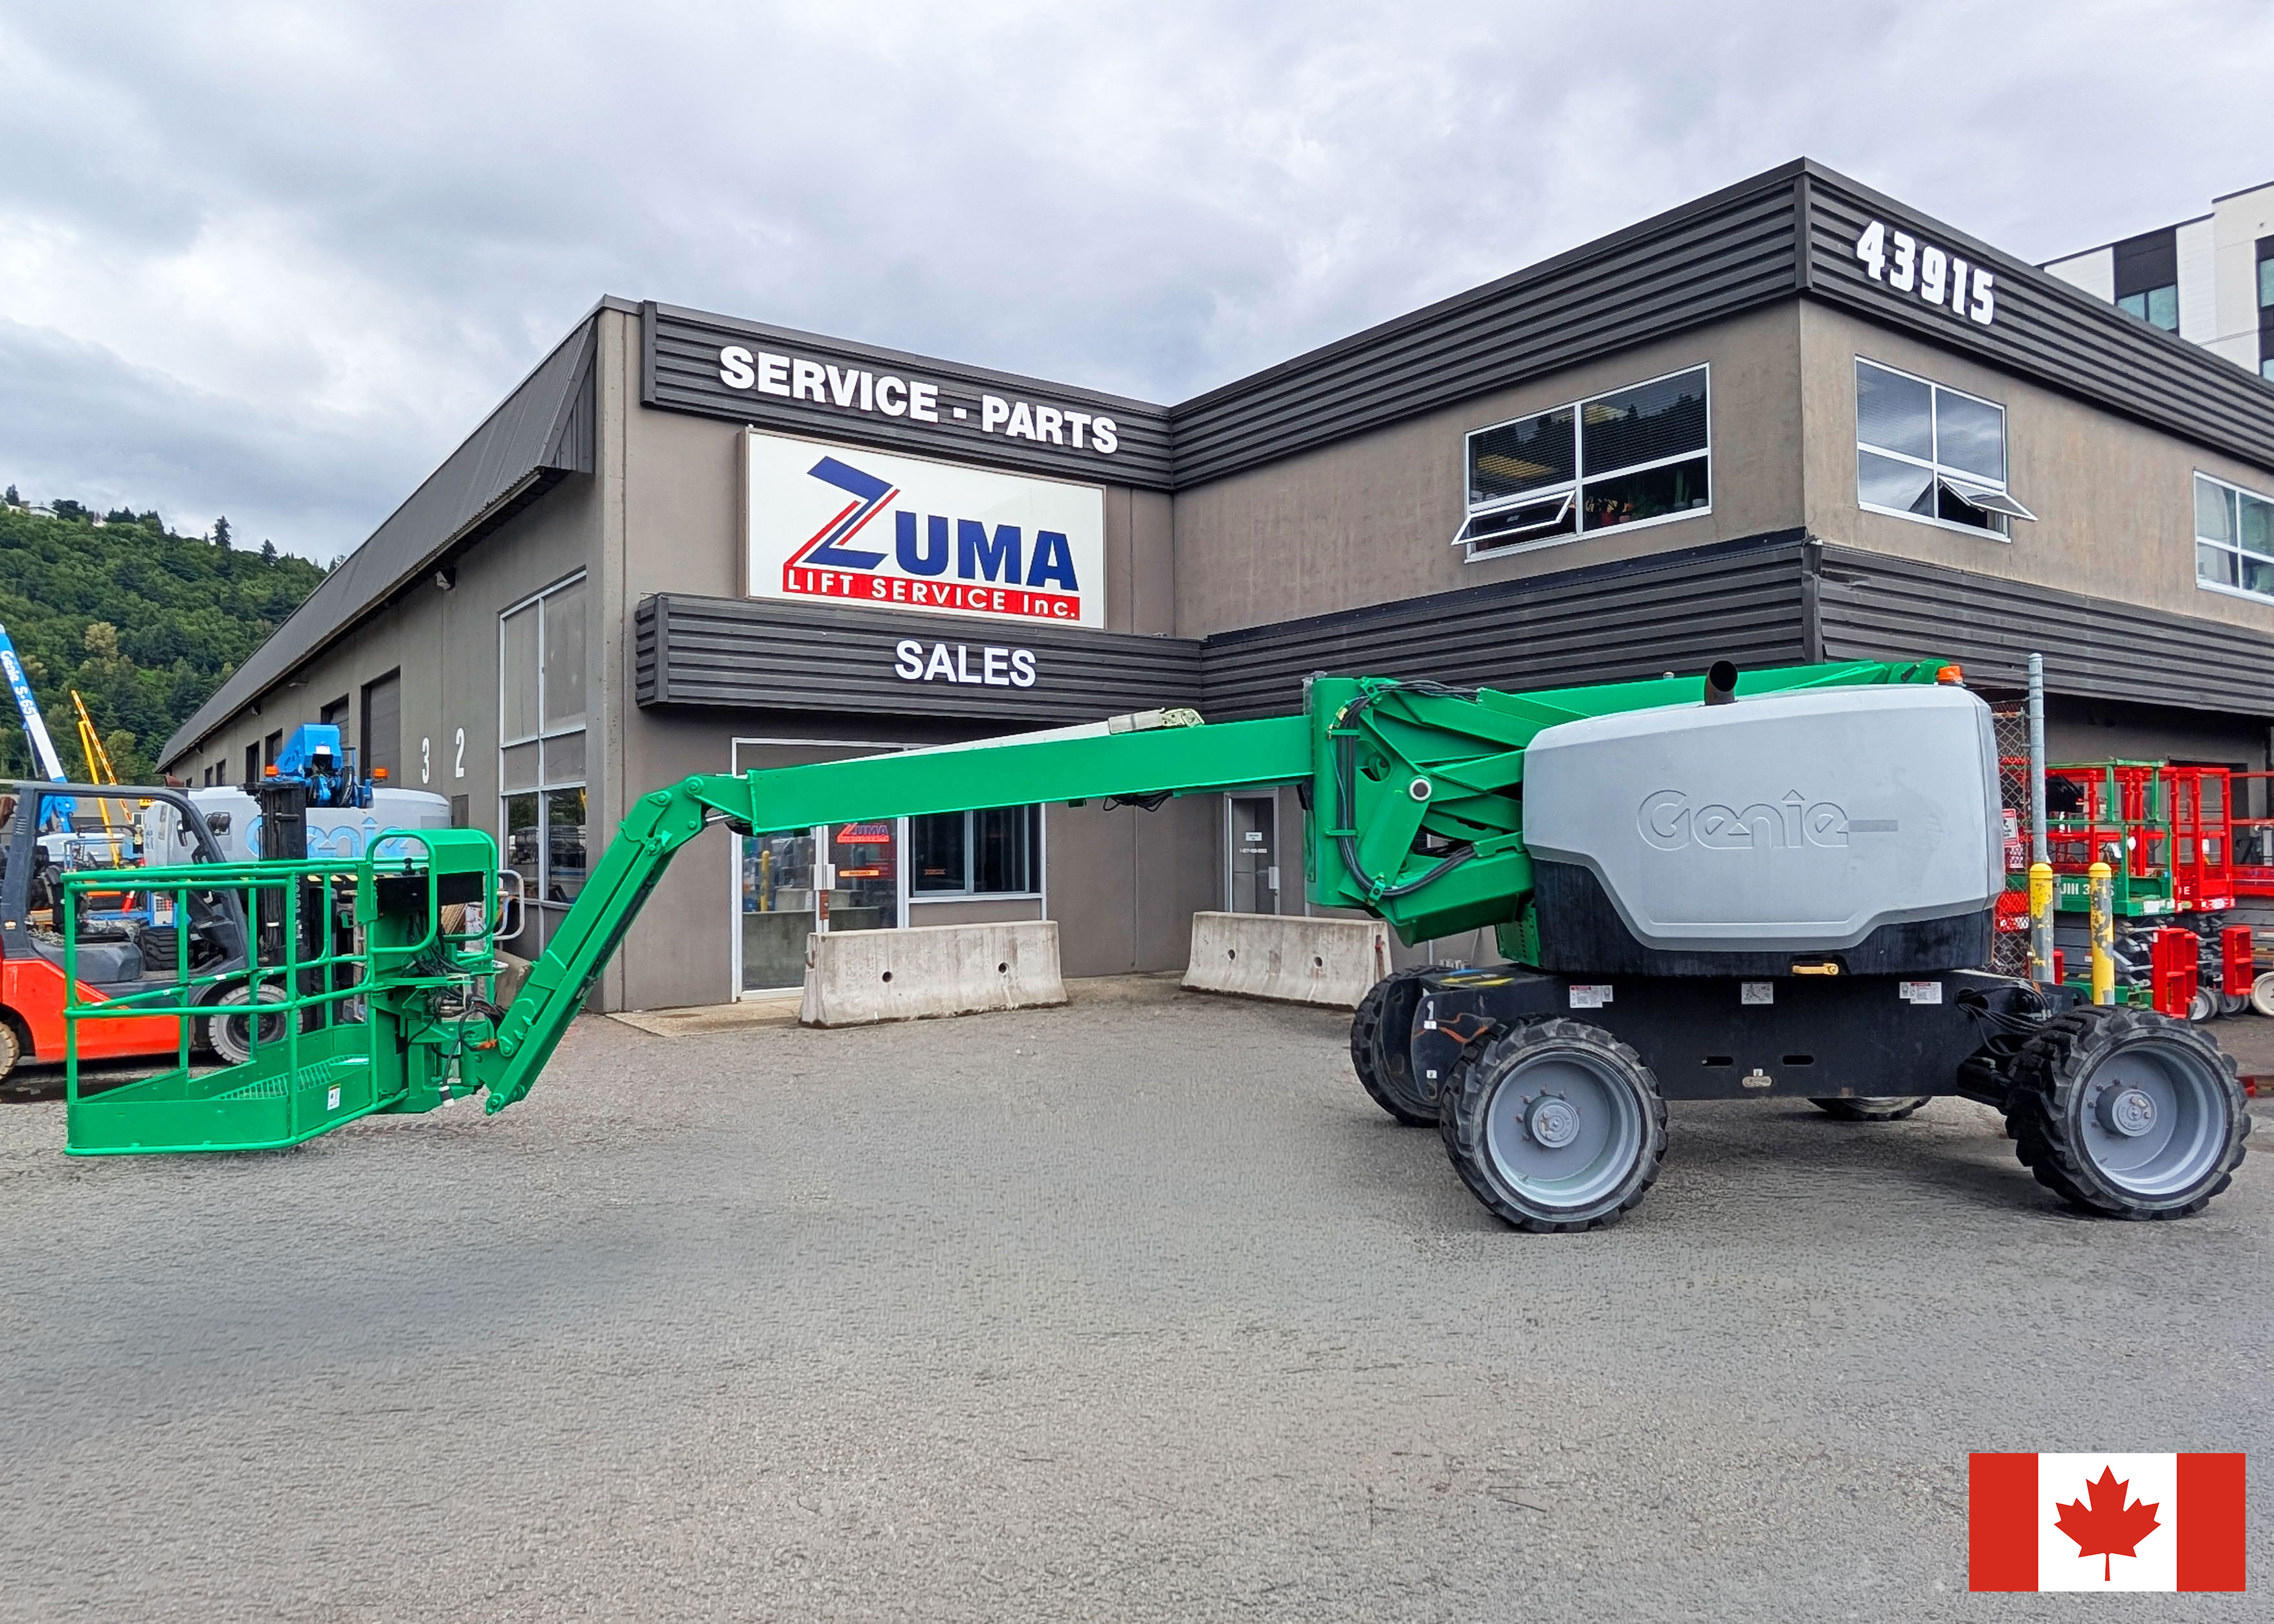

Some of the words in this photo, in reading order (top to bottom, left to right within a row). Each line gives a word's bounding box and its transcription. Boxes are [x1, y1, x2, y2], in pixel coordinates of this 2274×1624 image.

[1856, 220, 1994, 325] 43915
[720, 346, 938, 423] SERVICE
[982, 395, 1118, 454] PARTS
[788, 456, 1079, 592] ZUMA
[788, 570, 854, 595] LIFT
[872, 579, 1005, 610] SERVICE
[1023, 594, 1076, 617] Inc.
[1, 650, 20, 683] Genie
[15, 685, 37, 715] S-65
[895, 640, 1036, 687] SALES
[422, 737, 430, 784] 3
[455, 728, 465, 778] 2
[1636, 788, 1849, 851] Genie
